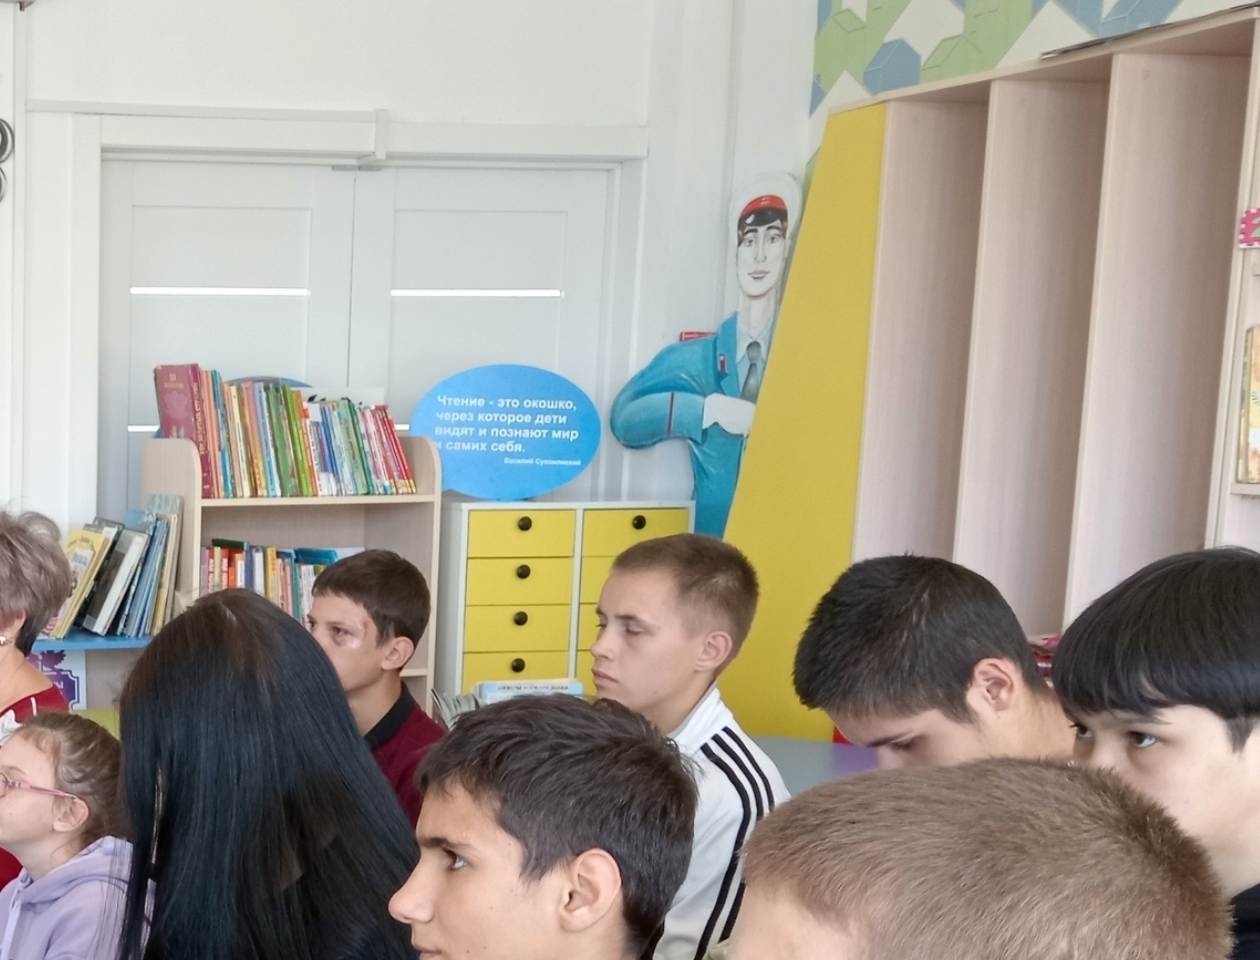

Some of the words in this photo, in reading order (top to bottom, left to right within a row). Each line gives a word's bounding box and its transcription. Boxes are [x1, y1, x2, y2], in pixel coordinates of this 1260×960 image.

[437, 395, 485, 407] Чтение
[497, 398, 520, 409] это
[523, 399, 577, 411] окошко,
[436, 412, 474, 424] через
[478, 413, 532, 426] которое
[534, 414, 567, 425] дети
[435, 426, 474, 437] видят
[478, 428, 487, 437] и
[491, 428, 549, 439] познают
[551, 430, 579, 443] мир
[446, 441, 487, 451] самих
[491, 441, 525, 453] себя.
